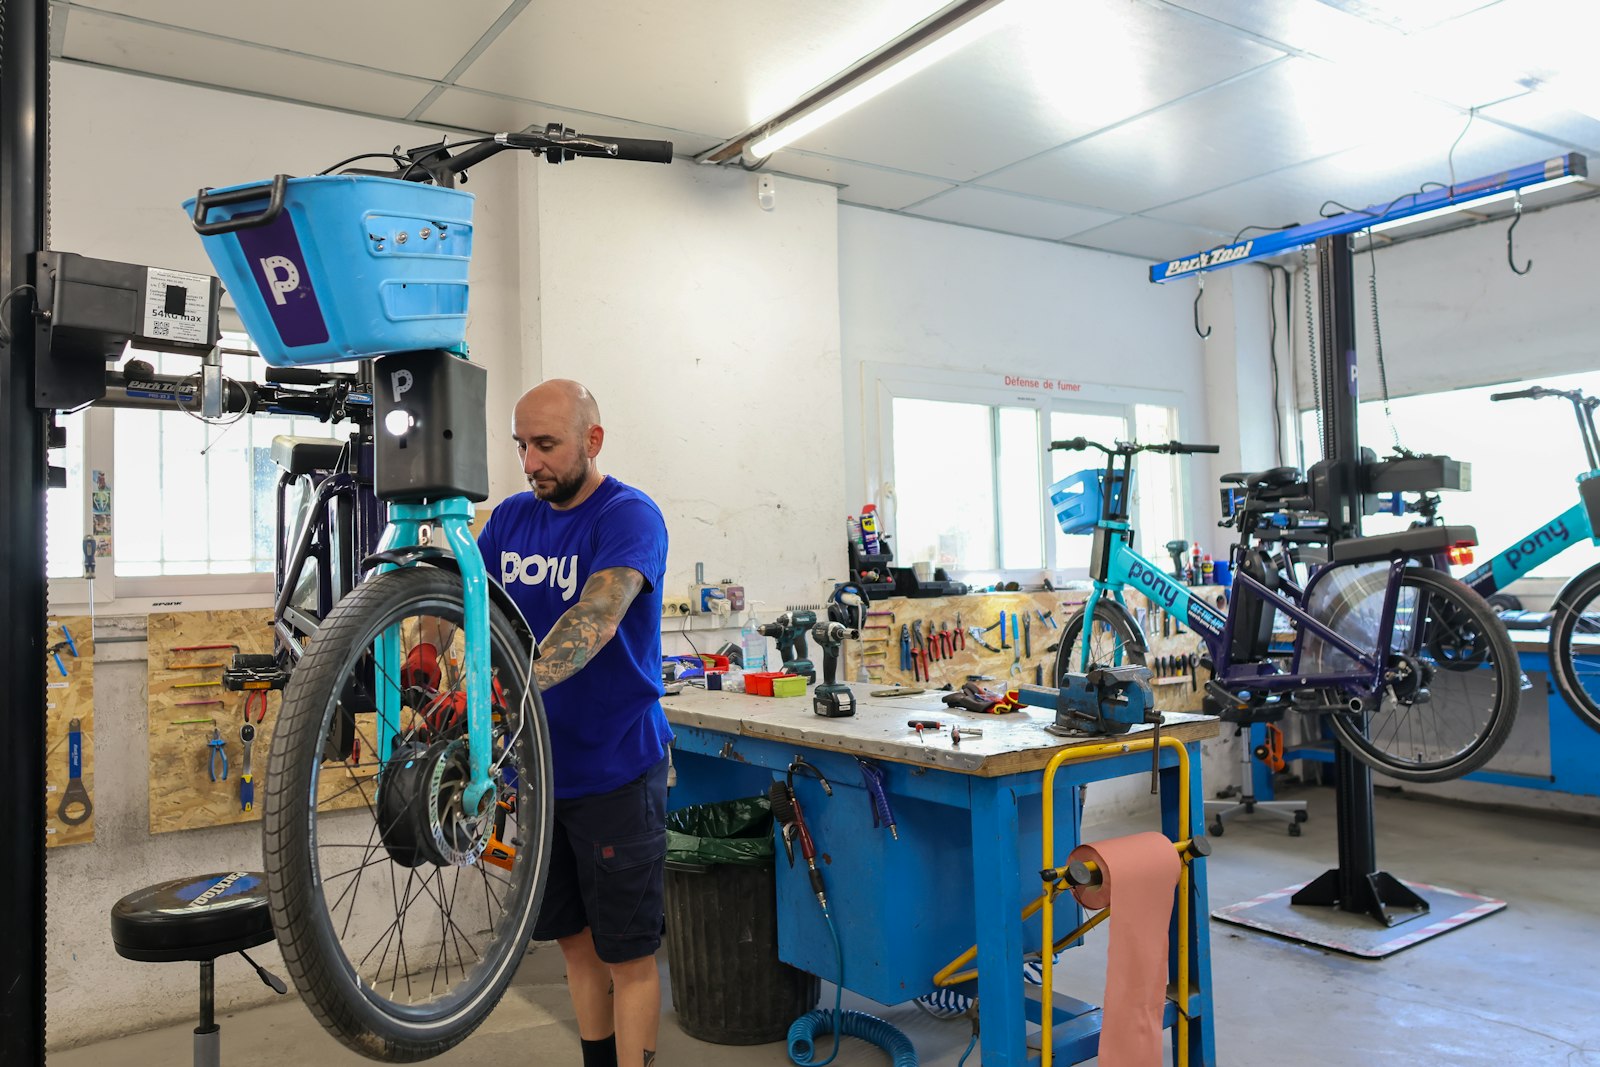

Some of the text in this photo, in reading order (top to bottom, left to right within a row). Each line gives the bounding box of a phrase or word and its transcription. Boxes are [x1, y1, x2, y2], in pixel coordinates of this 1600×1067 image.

[1043, 380, 1054, 390] de
[1057, 381, 1082, 392] fumer
[1504, 519, 1570, 571] pony
[501, 551, 579, 602] pony
[1128, 560, 1179, 608] pony
